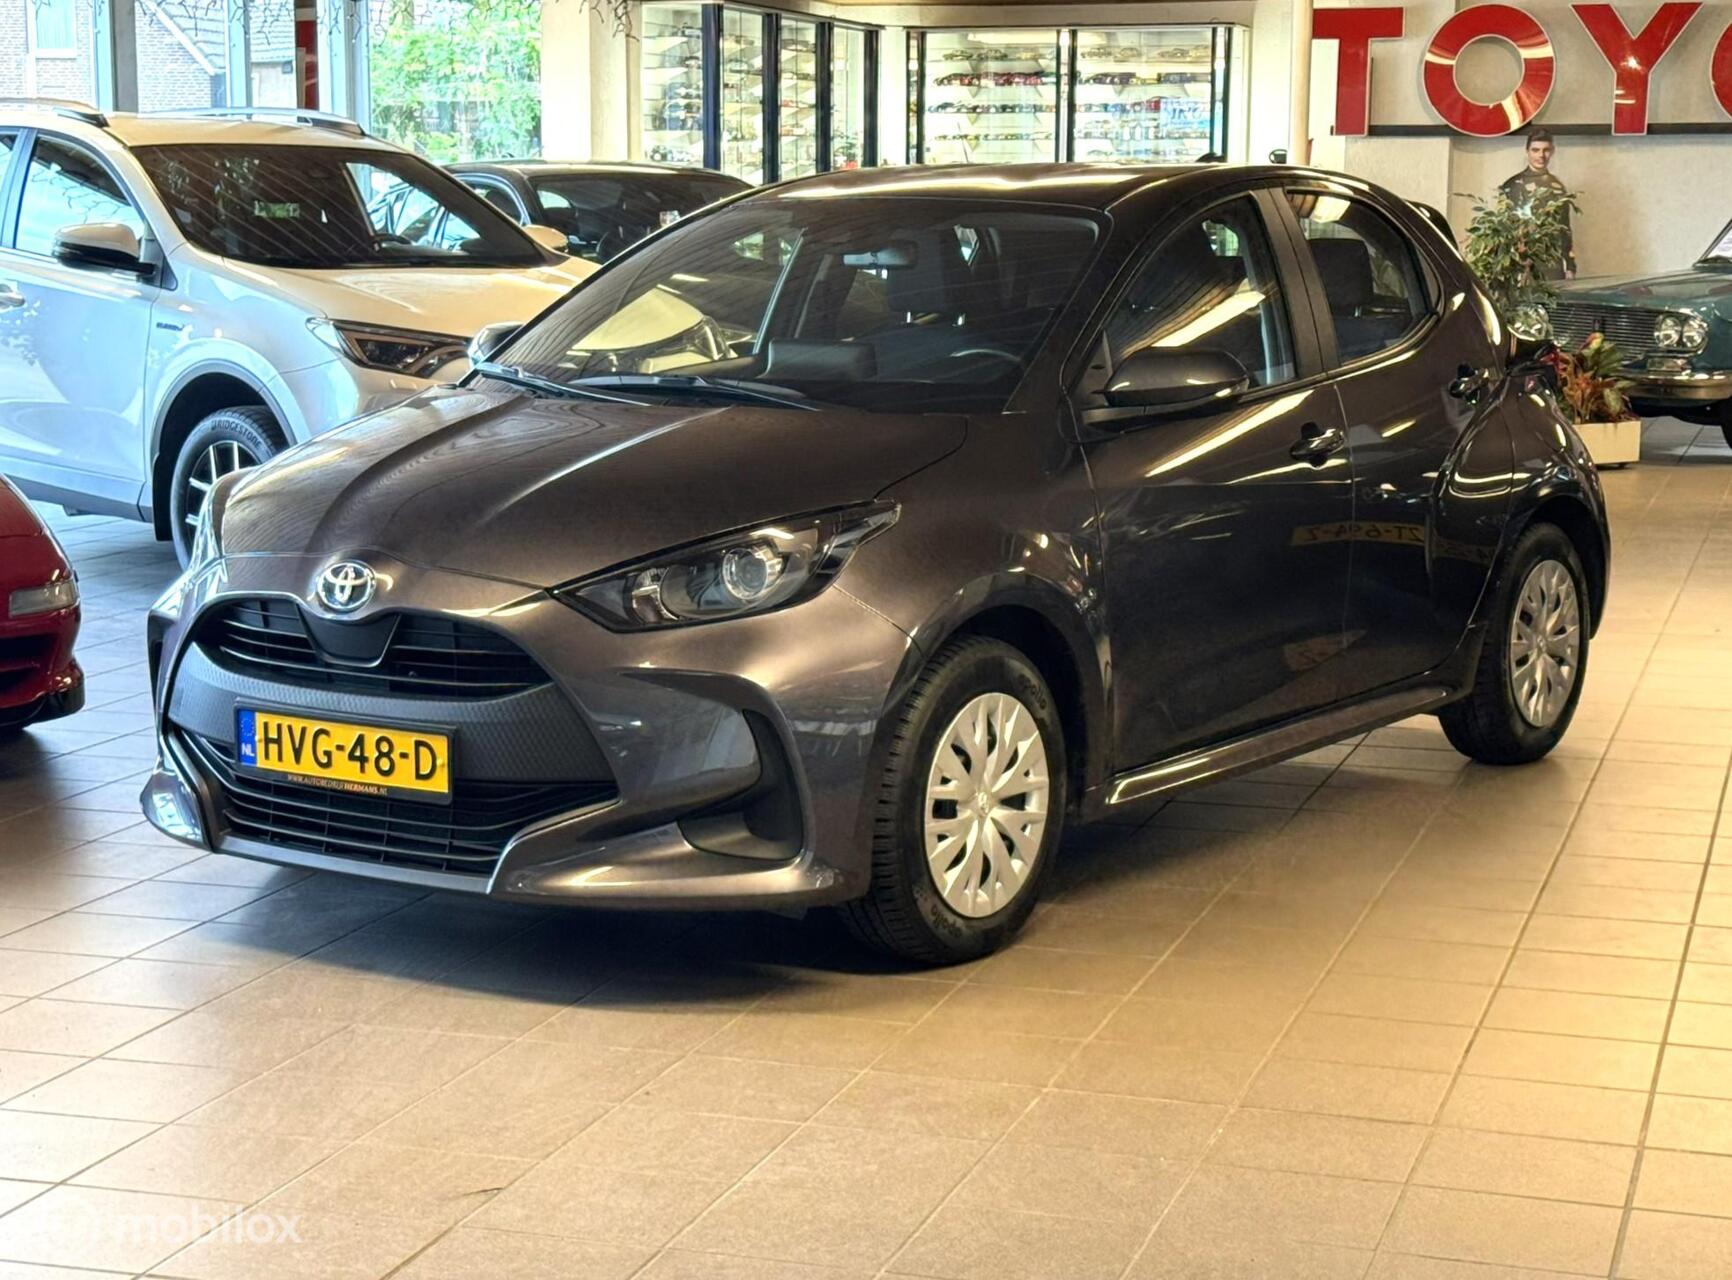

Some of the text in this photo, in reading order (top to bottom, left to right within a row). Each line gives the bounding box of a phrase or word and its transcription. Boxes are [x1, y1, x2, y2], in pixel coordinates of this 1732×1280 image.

[1313, 2, 1732, 136] TOY
[241, 743, 255, 757] NL
[262, 720, 438, 781] HVG-48-D
